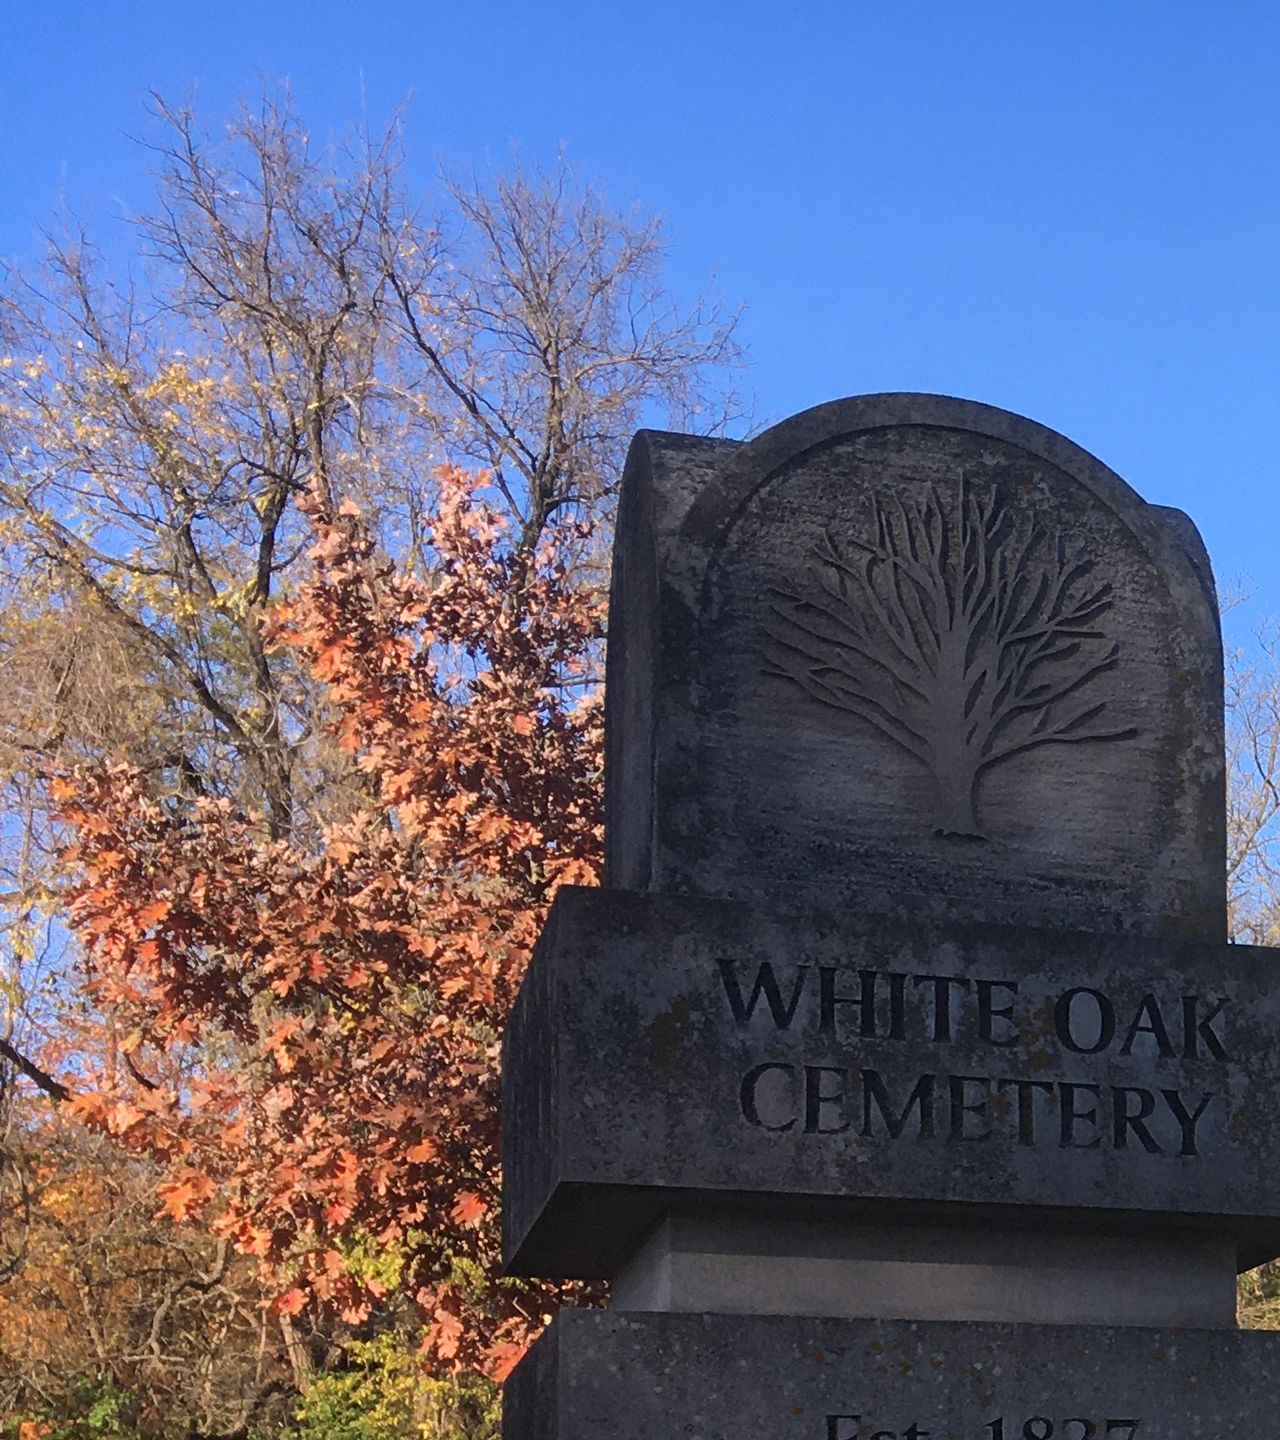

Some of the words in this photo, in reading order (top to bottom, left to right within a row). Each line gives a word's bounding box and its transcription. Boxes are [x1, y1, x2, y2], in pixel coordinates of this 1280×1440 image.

[718, 957, 1020, 1047] WHITE
[1054, 986, 1234, 1063] OAK
[740, 1062, 1215, 1156] CEMETERY
